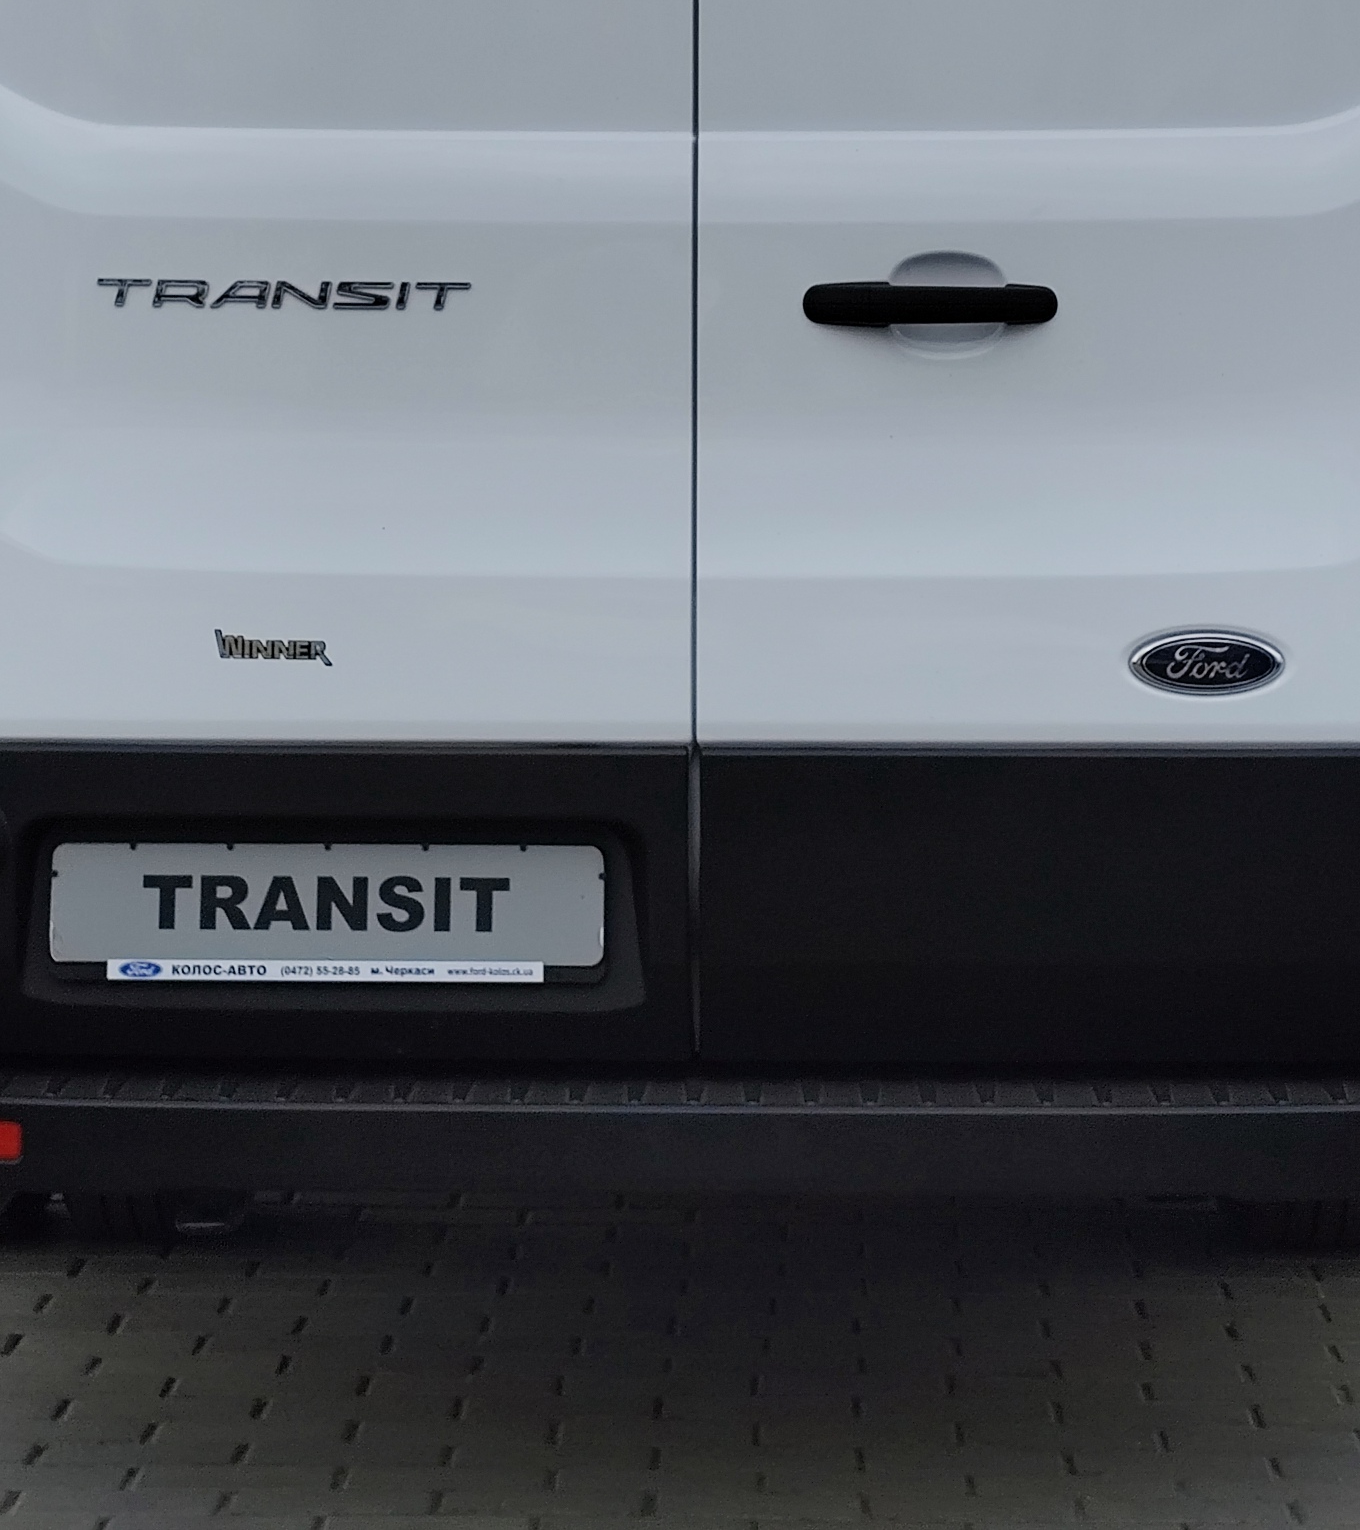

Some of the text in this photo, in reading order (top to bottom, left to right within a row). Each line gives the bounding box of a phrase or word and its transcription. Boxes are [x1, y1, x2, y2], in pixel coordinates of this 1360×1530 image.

[96, 277, 472, 312] TRANSIT
[213, 628, 333, 667] WINNER
[1166, 644, 1251, 680] Ford
[142, 873, 510, 933] TRANSIT
[171, 963, 268, 976] КОЛОС-АВТО
[280, 965, 314, 977] (0472)
[385, 965, 436, 977] Черкаси
